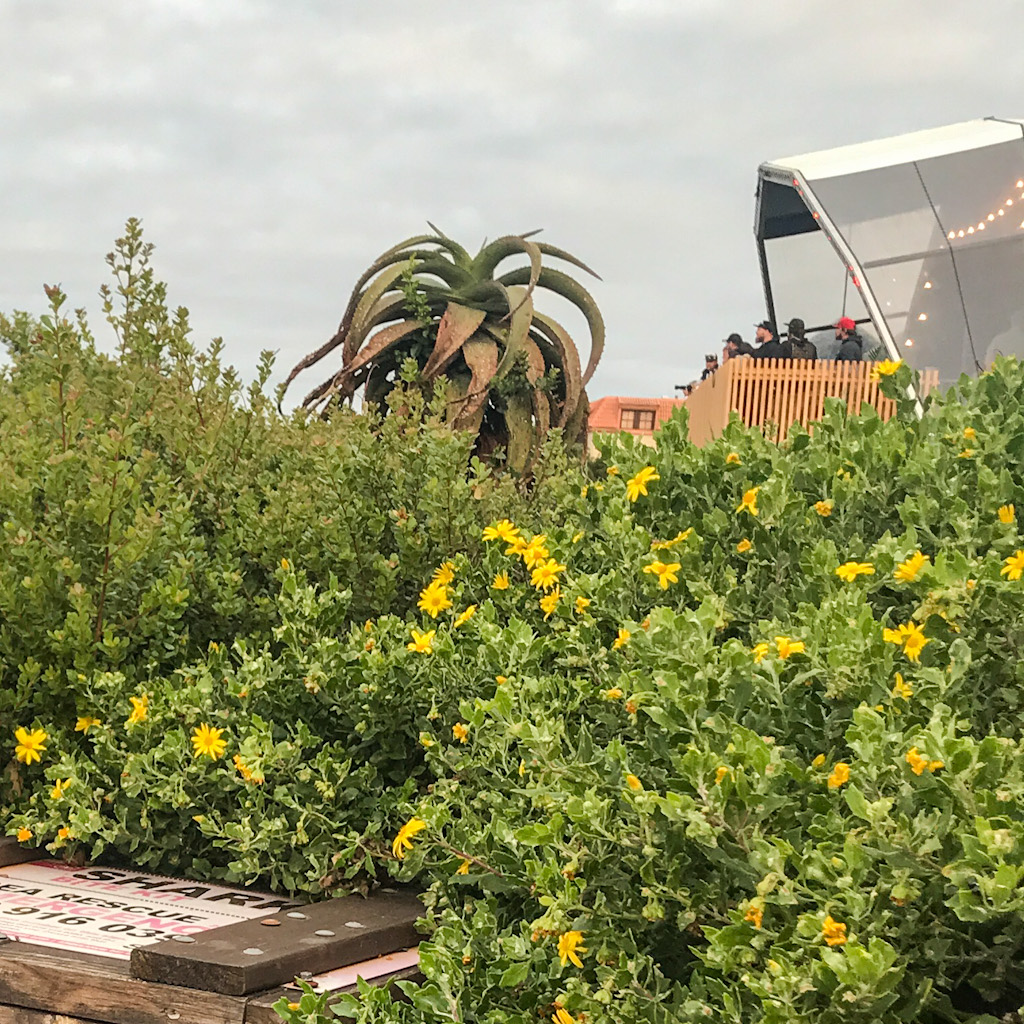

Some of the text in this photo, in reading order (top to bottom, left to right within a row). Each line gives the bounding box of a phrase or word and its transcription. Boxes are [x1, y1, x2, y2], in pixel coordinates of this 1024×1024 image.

[50, 876, 192, 902] BITE KIT
[2, 905, 97, 925] 916
[47, 892, 207, 924] RESCUE
